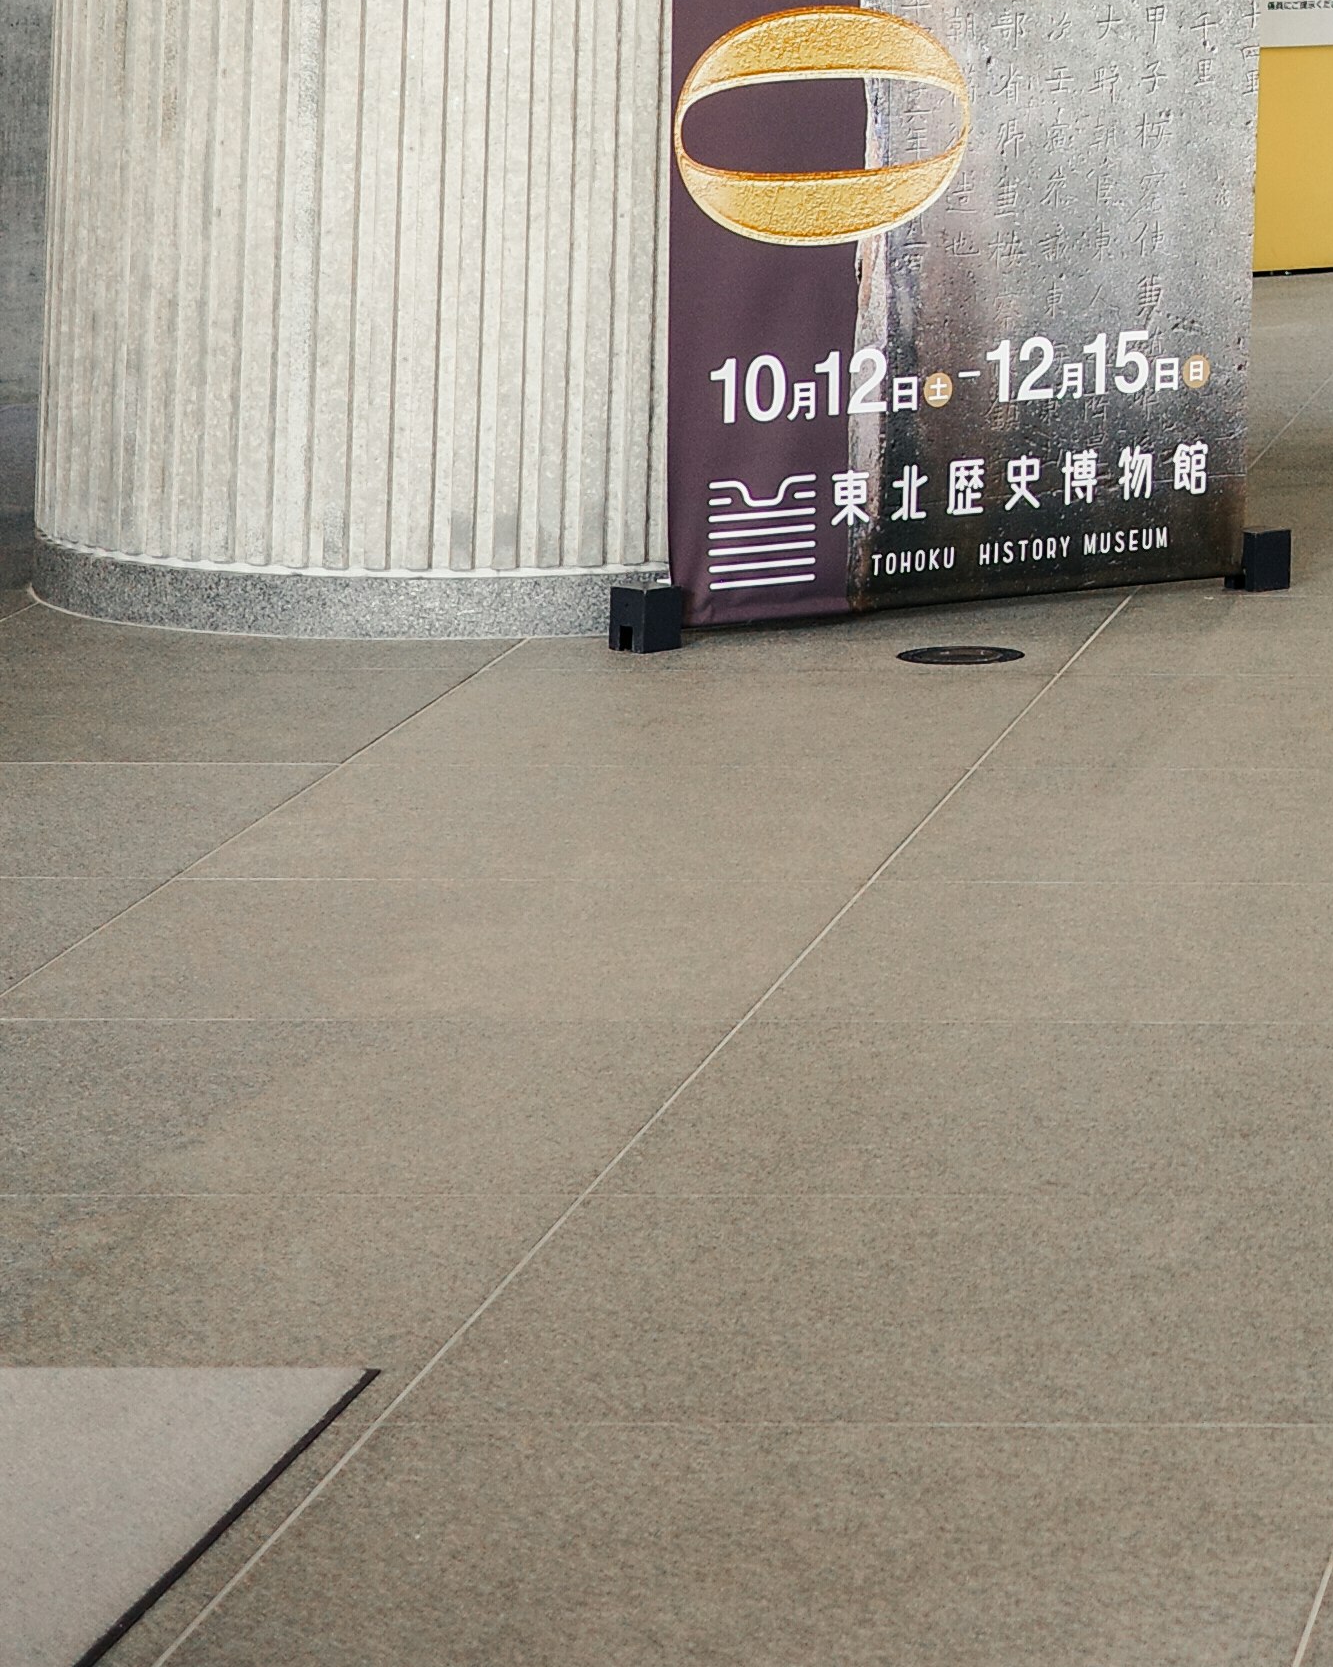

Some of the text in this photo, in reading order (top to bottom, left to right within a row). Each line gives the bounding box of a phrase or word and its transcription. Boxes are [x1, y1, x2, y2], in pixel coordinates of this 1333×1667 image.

[830, 440, 1210, 528] 東北歴史博物館
[871, 525, 1170, 576] TOHOKU HISTORY MUSEUM
